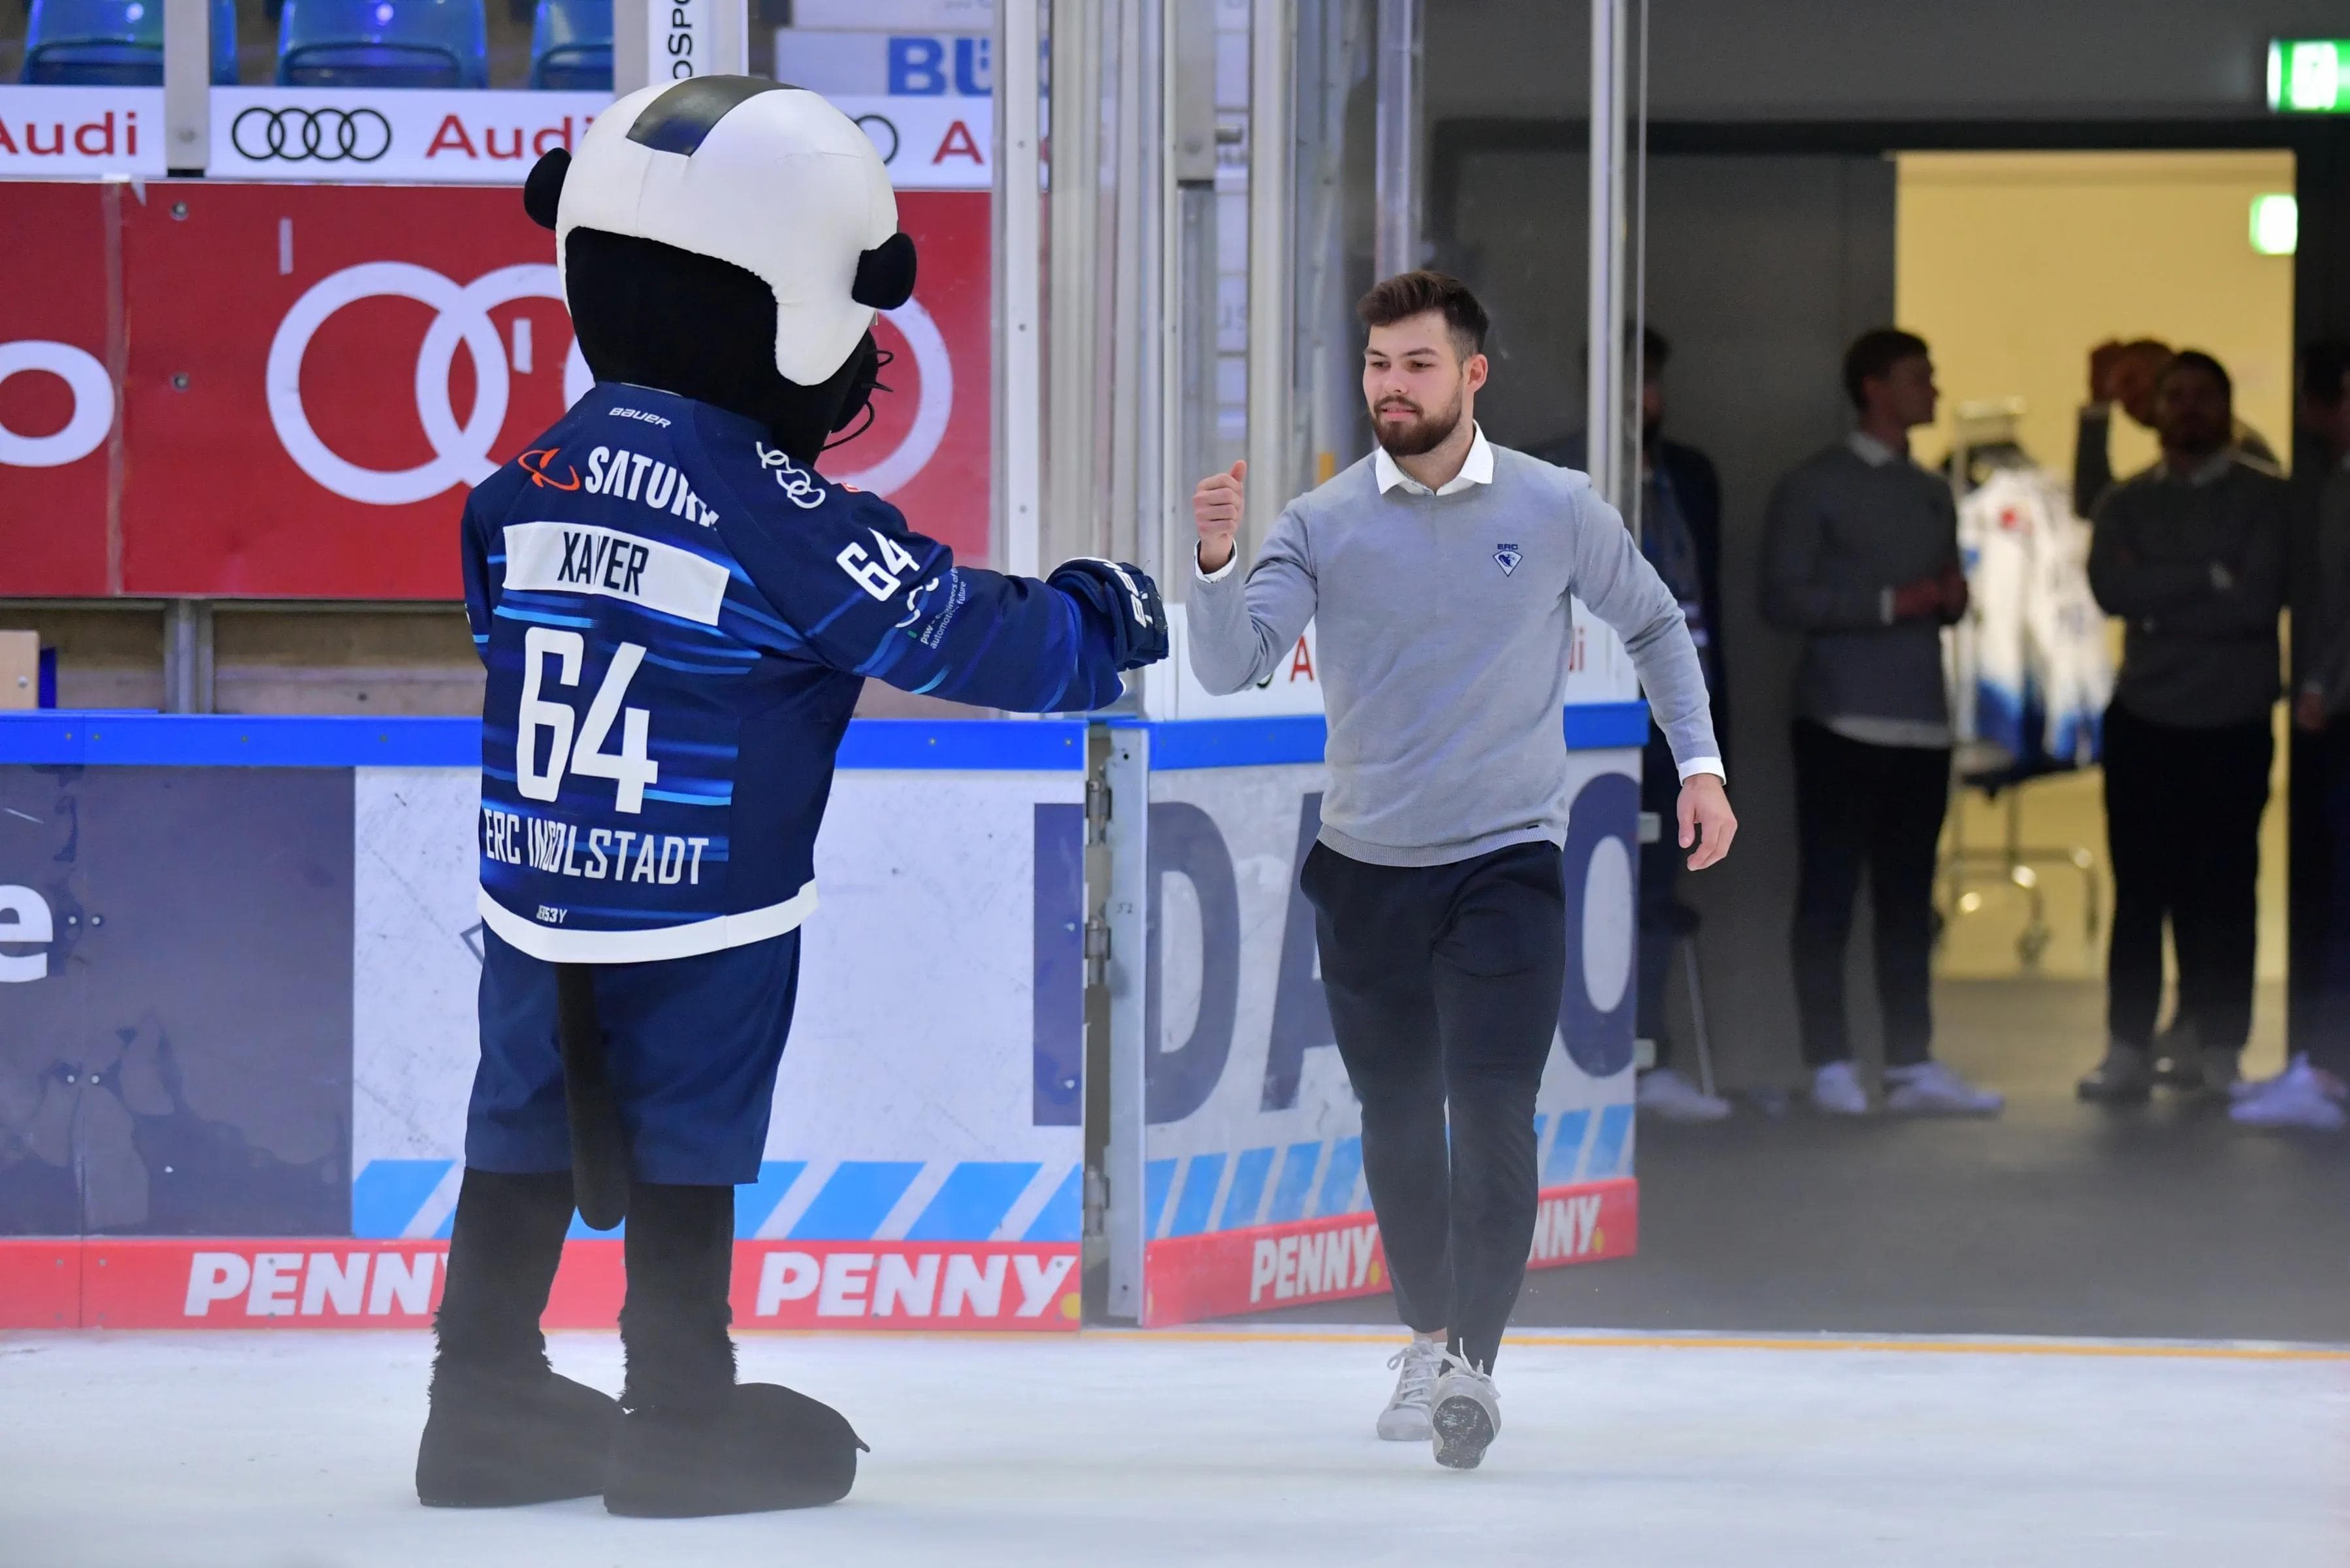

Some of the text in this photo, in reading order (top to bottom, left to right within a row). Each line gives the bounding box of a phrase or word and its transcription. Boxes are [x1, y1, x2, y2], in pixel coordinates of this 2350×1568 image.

[426, 114, 595, 159] Aud
[557, 531, 649, 596] XAVER
[836, 527, 921, 602] 64
[516, 626, 659, 814] 64
[483, 808, 521, 865] ERC
[184, 1252, 449, 1316] PENN
